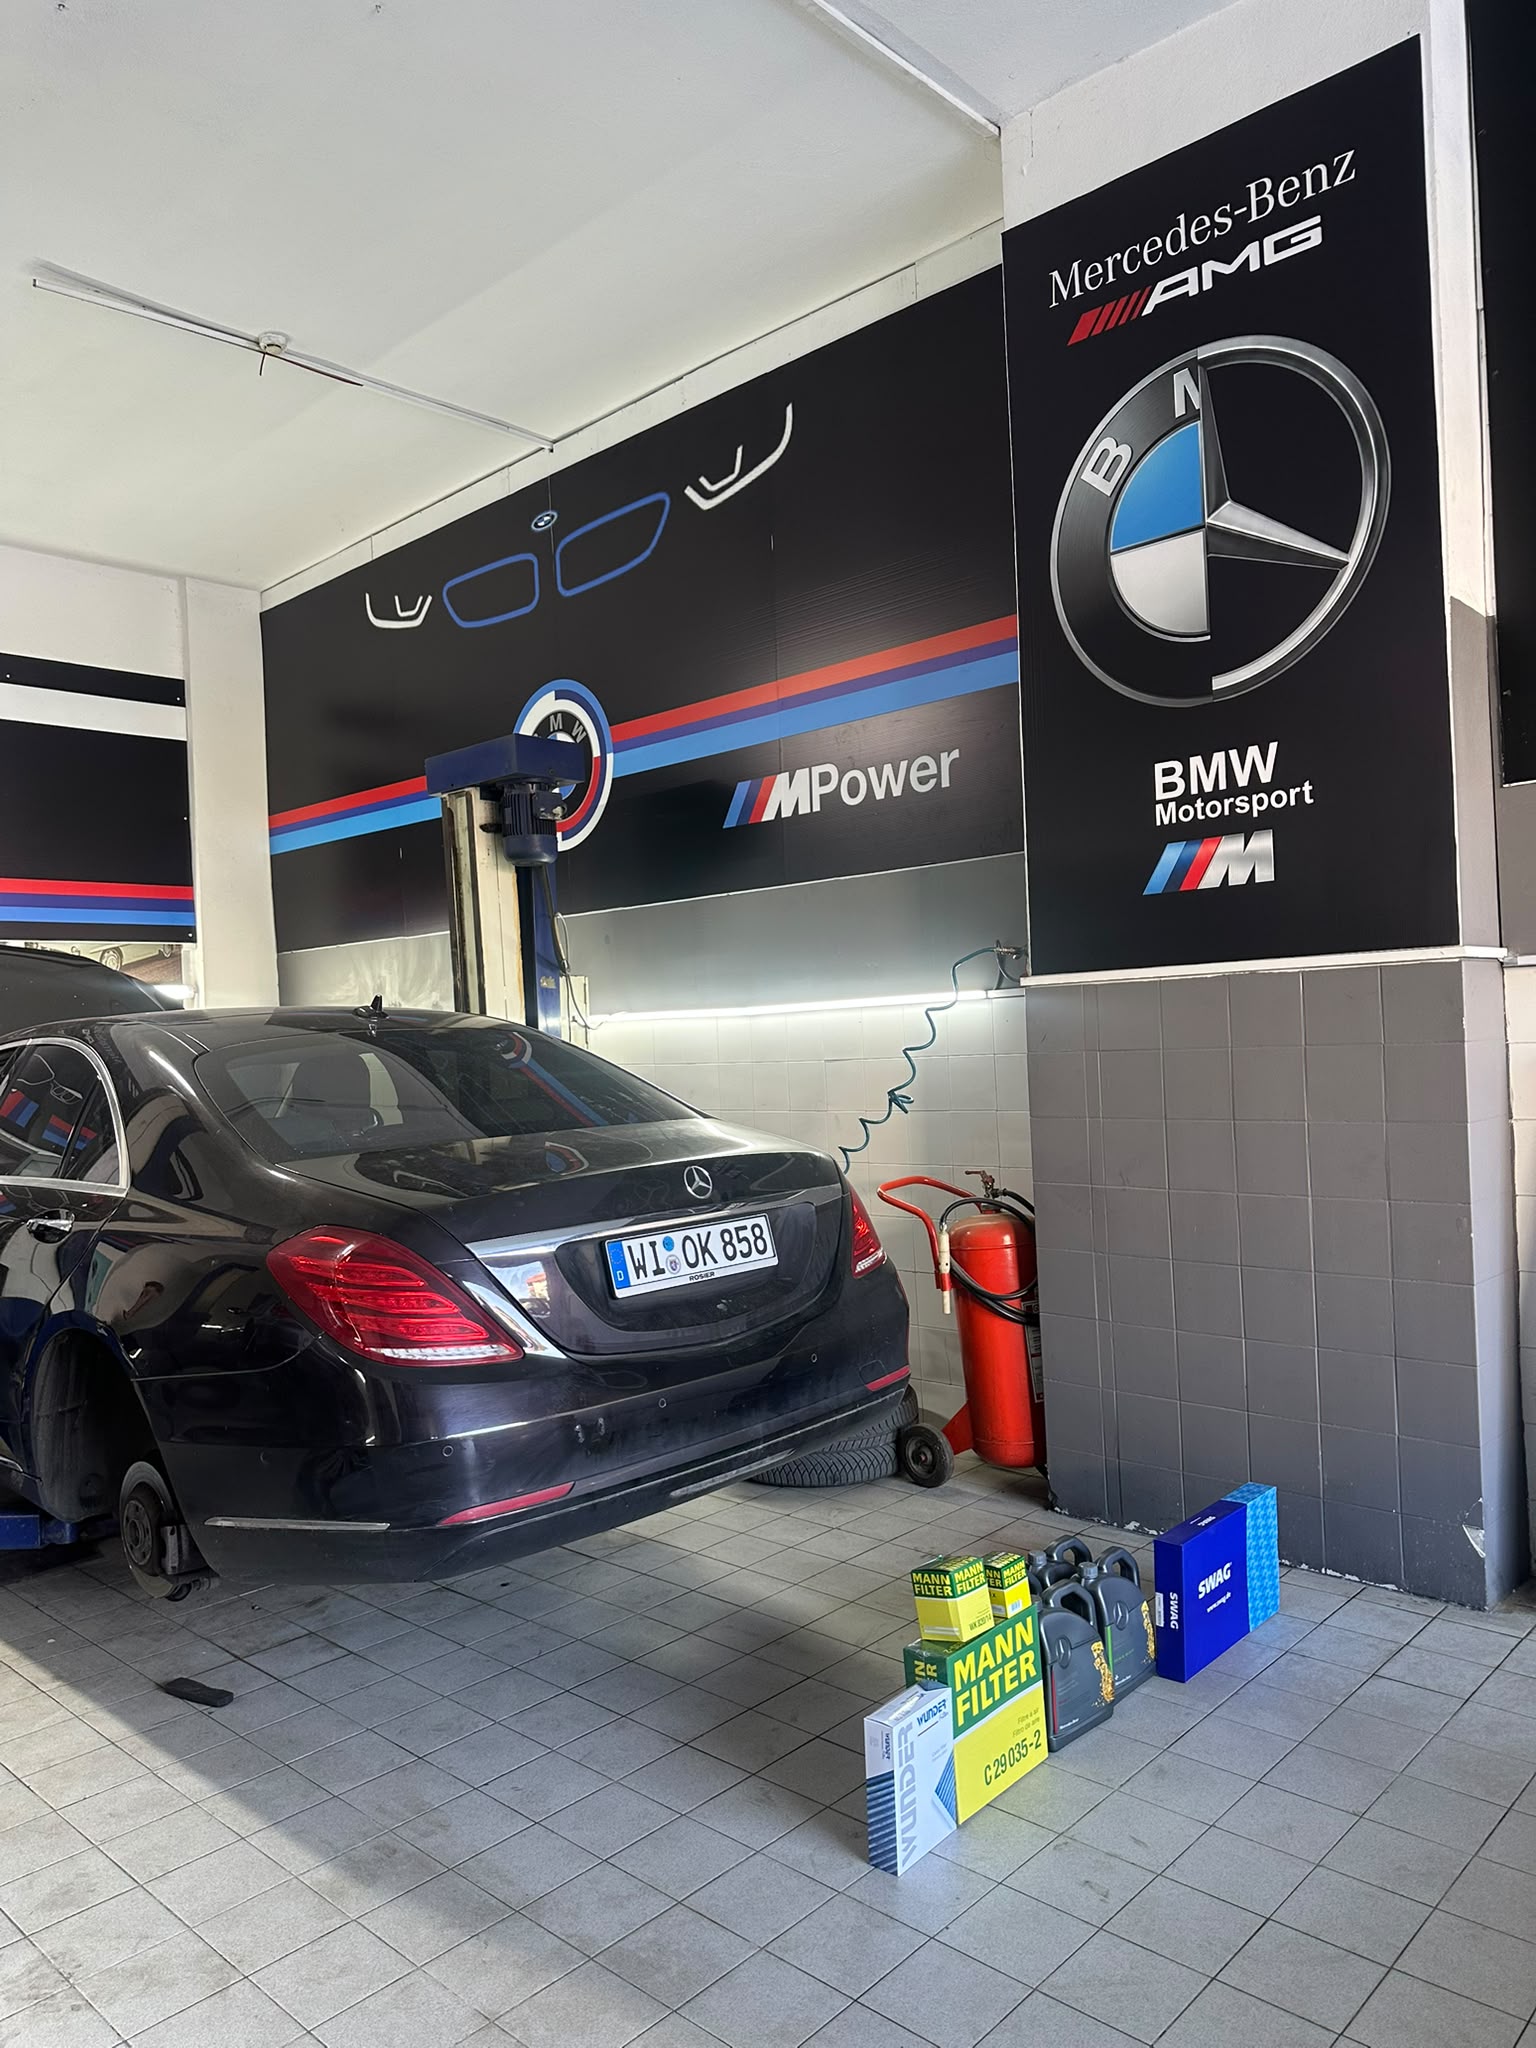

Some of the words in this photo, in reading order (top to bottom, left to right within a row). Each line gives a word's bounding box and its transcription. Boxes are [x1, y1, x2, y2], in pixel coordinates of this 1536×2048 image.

[1049, 149, 1356, 309] Mercedes-Benz
[1141, 214, 1323, 317] AMG
[1154, 741, 1279, 801] BMW
[1155, 779, 1315, 827] Motorsport
[627, 1240, 666, 1280] WI
[681, 1230, 719, 1269] OK
[719, 1223, 768, 1262] 858
[689, 1271, 715, 1282] ROSIER
[912, 1573, 950, 1585] MANN
[954, 1561, 984, 1583] MANN
[956, 1573, 986, 1595] FILTER
[1003, 1559, 1025, 1577] MANN
[1004, 1569, 1027, 1588] FILTER
[1198, 1565, 1231, 1600] SWAG
[914, 1584, 953, 1597] FILTER
[1169, 1592, 1179, 1630] SWAG
[954, 1615, 1034, 1693] MANN
[956, 1649, 1037, 1727] FILTER
[984, 1764, 991, 1786] C
[993, 1753, 1007, 1780] 29
[1008, 1729, 1042, 1768] 035-2
